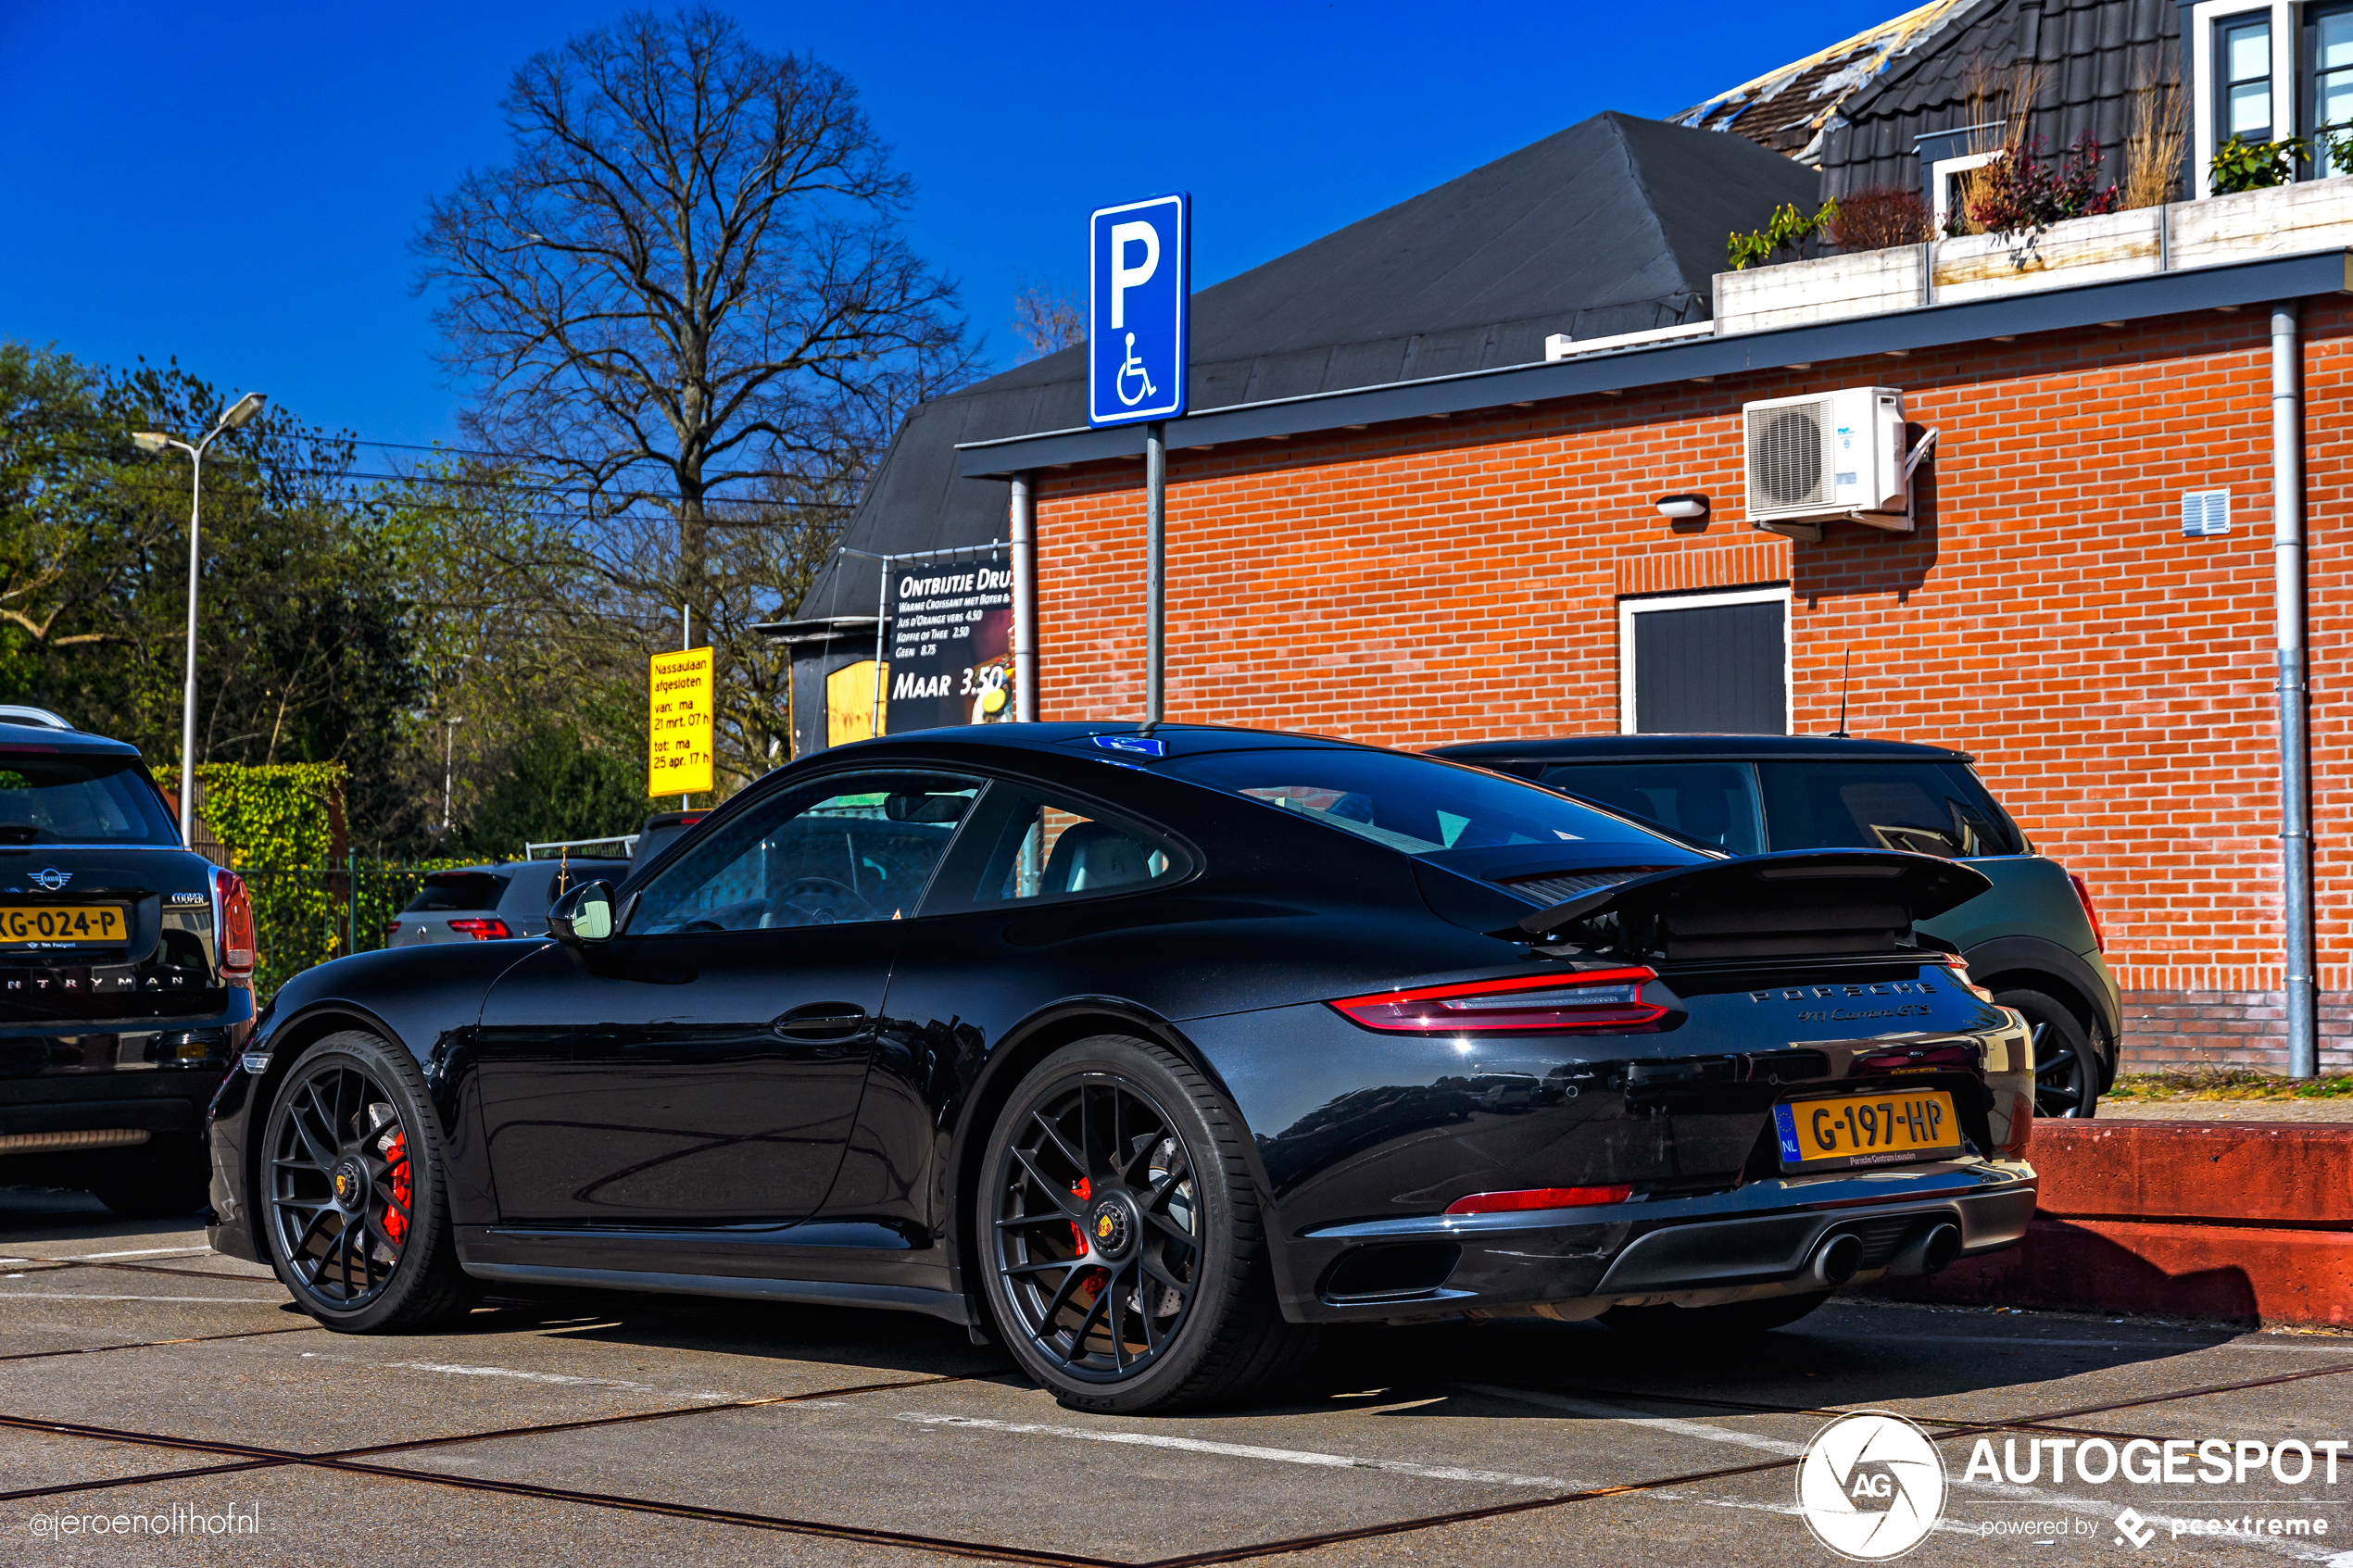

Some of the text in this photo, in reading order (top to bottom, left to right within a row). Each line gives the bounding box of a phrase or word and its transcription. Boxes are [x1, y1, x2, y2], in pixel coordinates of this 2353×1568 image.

[1111, 220, 1161, 330] P
[899, 601, 925, 613] WARME
[925, 596, 963, 611] CROISSANT
[963, 596, 980, 607] MET
[979, 593, 1004, 605] BOTER
[897, 617, 911, 630] JUS
[947, 613, 964, 623] VERS
[965, 609, 984, 622] 4.50
[896, 625, 970, 644] KOFFIE OF THEE 2.50
[920, 644, 937, 657] 8.75
[654, 659, 707, 675] Nassaulaan
[654, 676, 701, 695] afgesloten
[892, 666, 1004, 701] MAAR 3.50
[654, 700, 694, 713] van: ma
[654, 712, 710, 731] 21 mrt. 07 h
[654, 739, 690, 752] tot: ma
[653, 751, 710, 769] 25 apr. 17 h
[171, 893, 204, 904] COOPER
[1749, 983, 1937, 1003] PORSCHE
[1797, 1004, 1932, 1022] 911 Carrera GTS
[1812, 1099, 1944, 1151] G-197-HP
[1781, 1140, 1797, 1153] NL
[1849, 1151, 1916, 1166] Porsche Centrum Leusden
